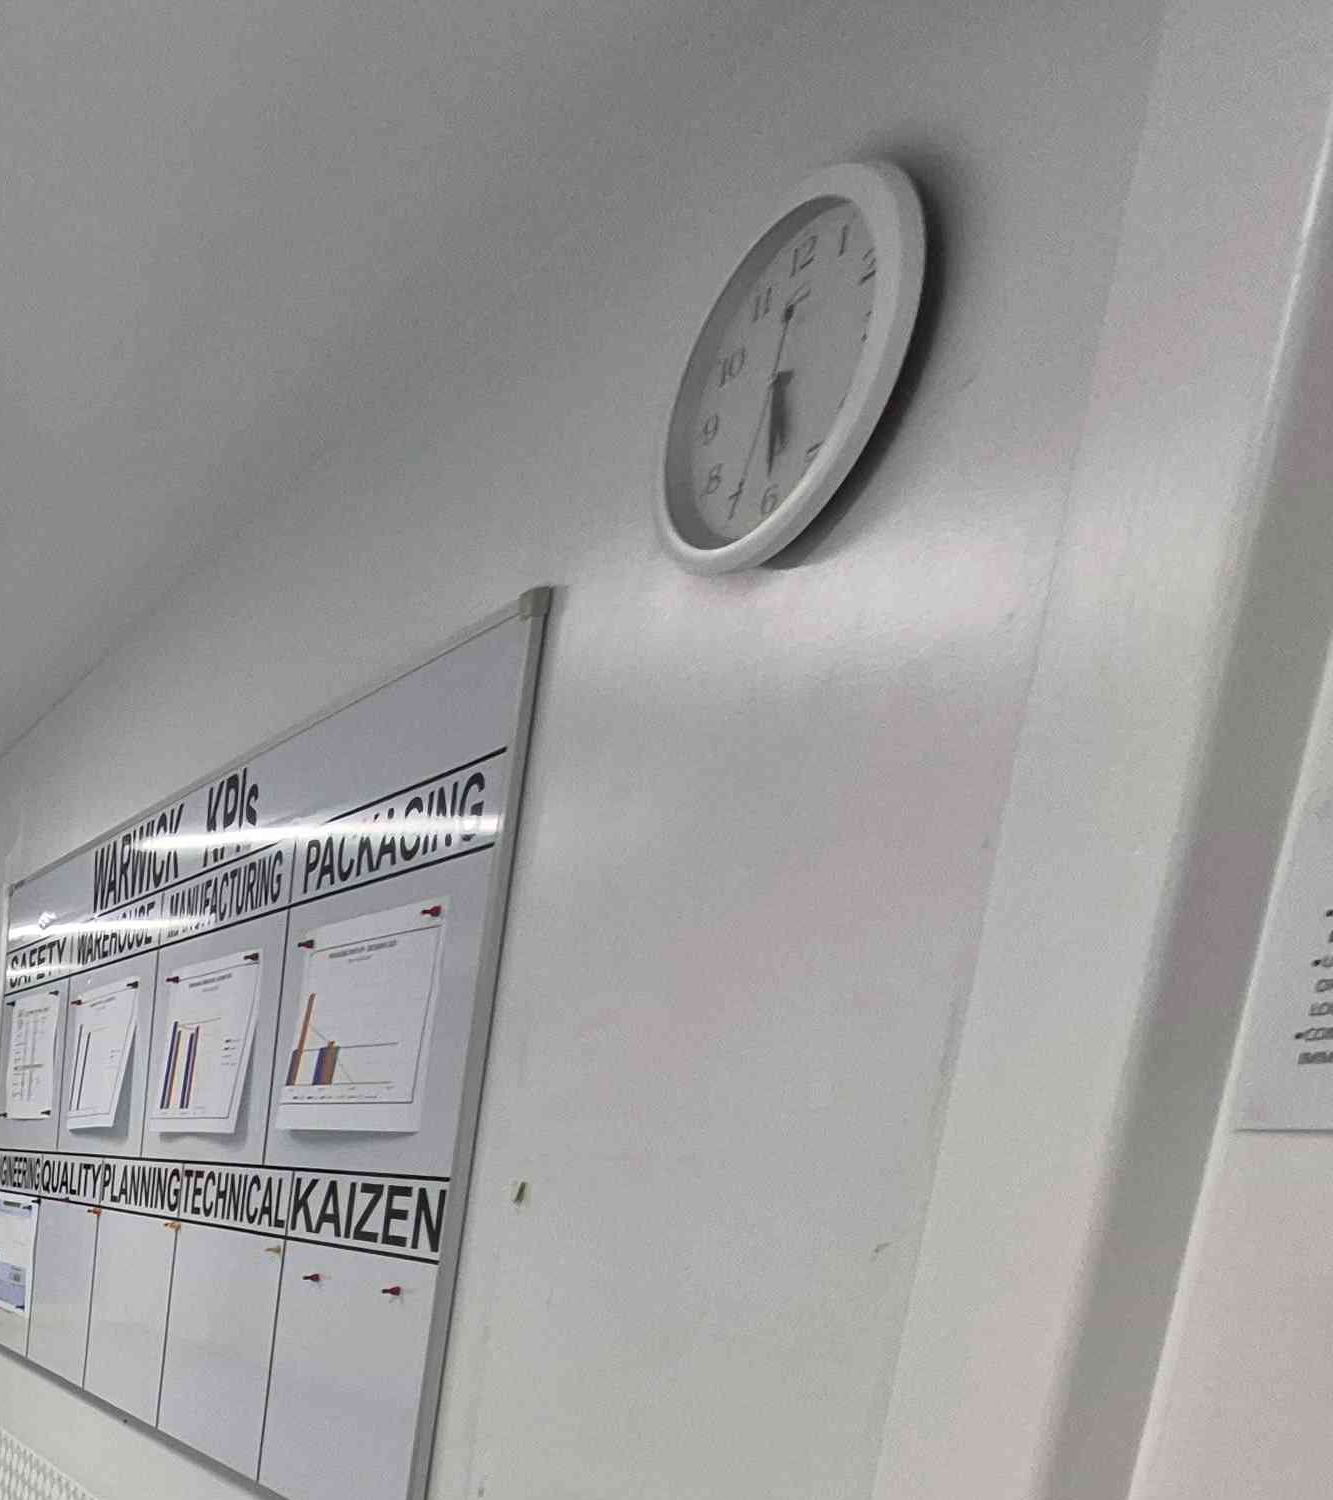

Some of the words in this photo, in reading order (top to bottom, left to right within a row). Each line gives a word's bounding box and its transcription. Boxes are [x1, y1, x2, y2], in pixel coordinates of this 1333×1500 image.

[789, 236, 818, 278] 12
[93, 803, 184, 913] WARWICK
[303, 772, 485, 894] PACKAGING
[166, 850, 283, 938] MANUFACTURING
[9, 937, 66, 989] SAFETY
[42, 1159, 101, 1198] QUALITY
[103, 1164, 181, 1212] PLANNING
[183, 1169, 286, 1229] TECHNICAL
[290, 1177, 447, 1253] KAIZEN
